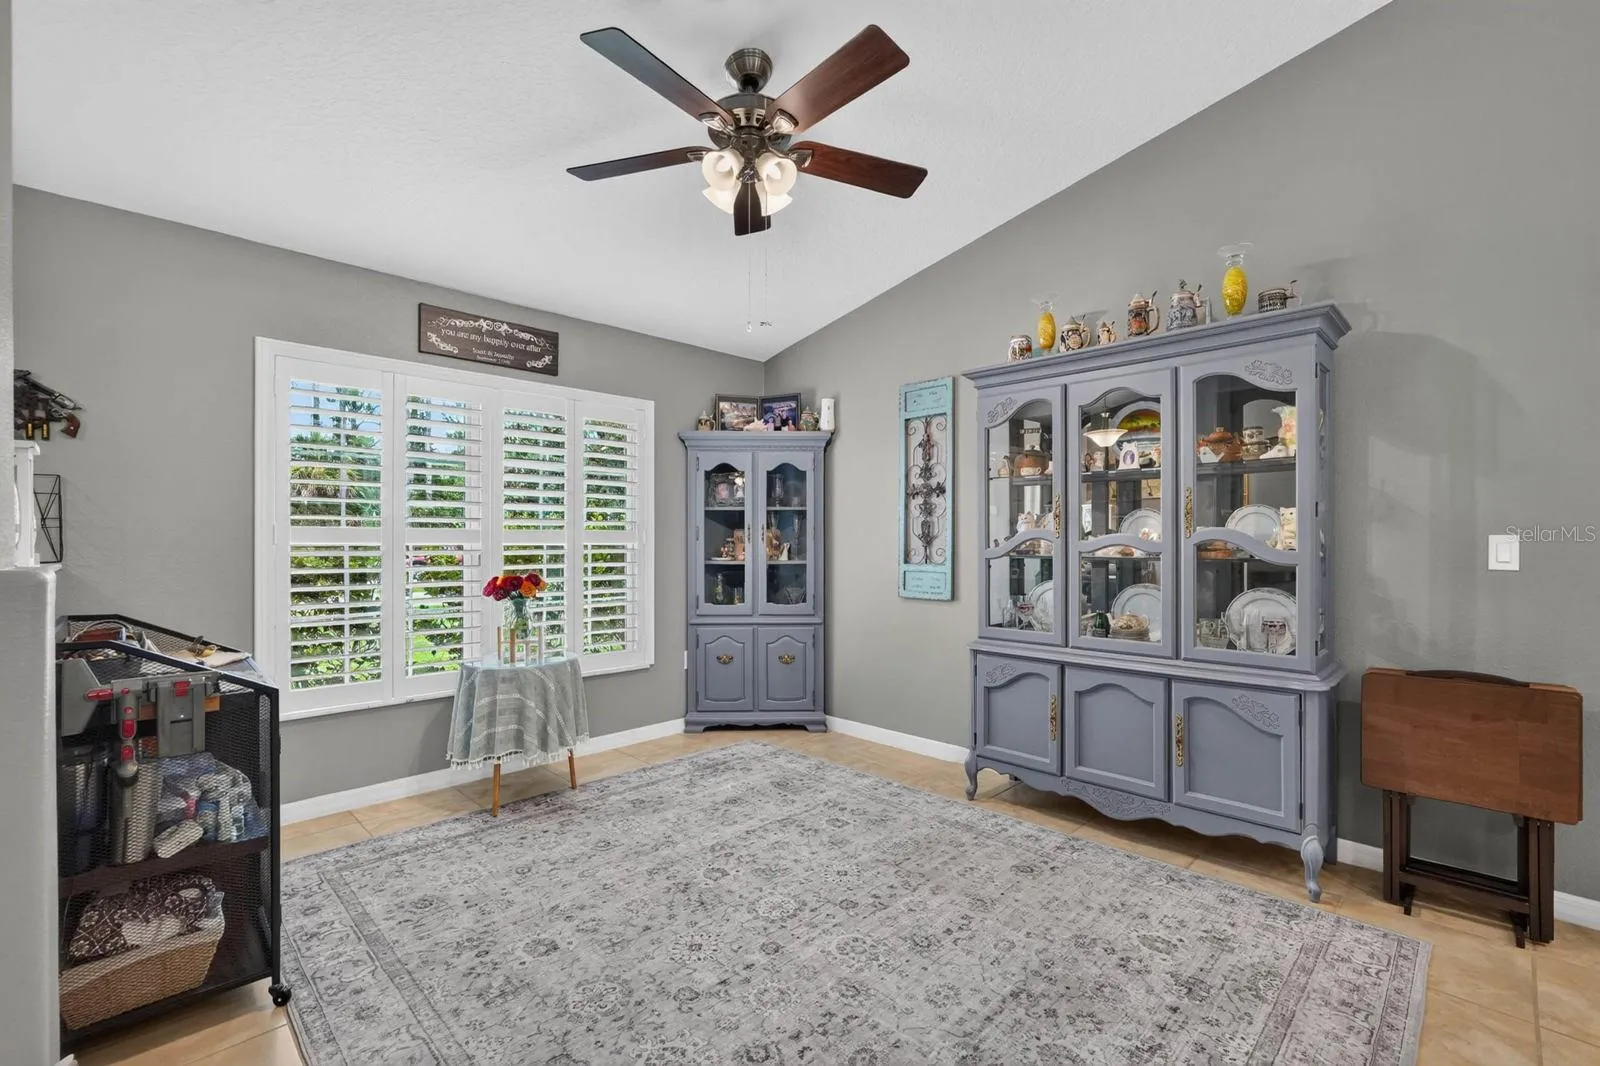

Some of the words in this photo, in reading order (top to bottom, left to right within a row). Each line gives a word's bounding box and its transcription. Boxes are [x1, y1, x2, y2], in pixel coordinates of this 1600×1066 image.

[441, 328, 456, 336] you
[457, 331, 469, 339] are
[470, 333, 482, 342] my
[483, 334, 509, 348] happily
